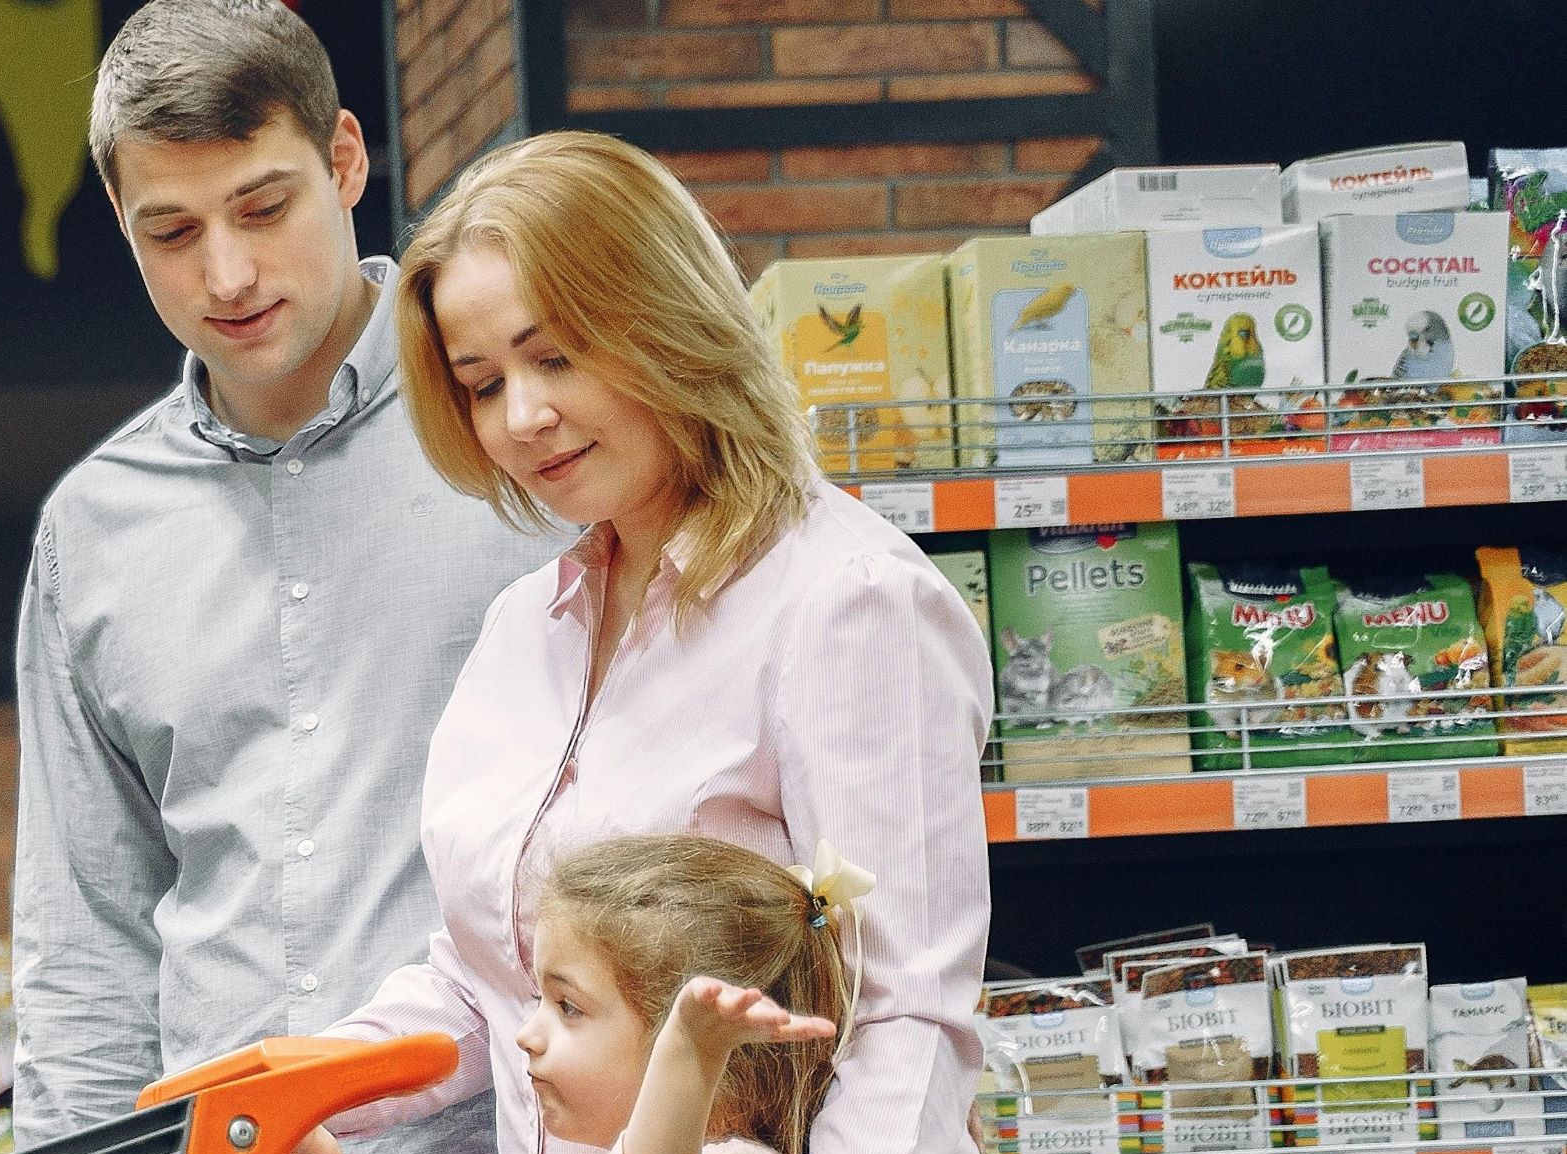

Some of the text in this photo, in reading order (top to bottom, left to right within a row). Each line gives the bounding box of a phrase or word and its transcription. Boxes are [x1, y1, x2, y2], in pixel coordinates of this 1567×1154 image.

[1173, 264, 1297, 290] КОКТЕЙЛЬ
[1368, 257, 1480, 274] COCKTAIL
[1387, 275, 1458, 290] budgie fruit
[1002, 339, 1081, 355] Канарка
[1027, 559, 1144, 594] Pellets
[1233, 603, 1314, 628] MU
[1363, 601, 1449, 627] MENU
